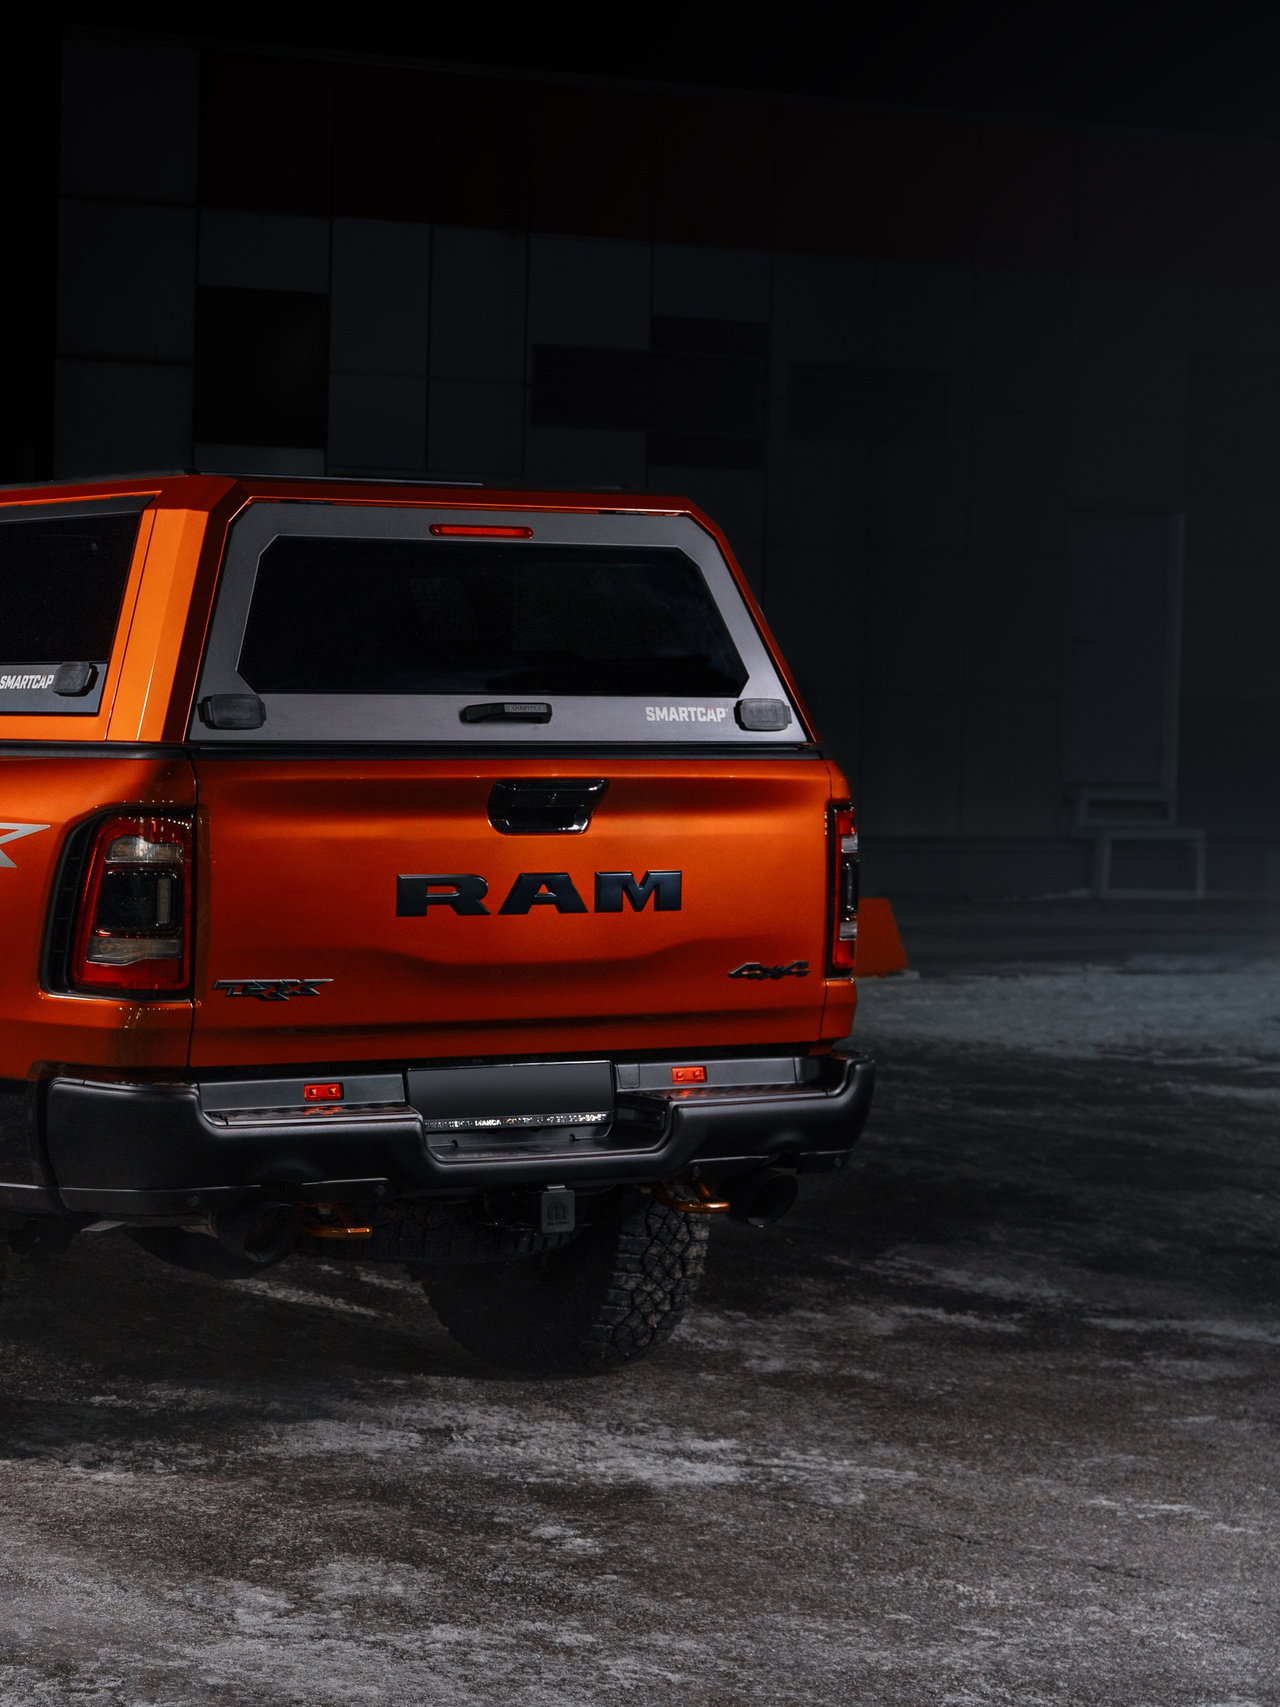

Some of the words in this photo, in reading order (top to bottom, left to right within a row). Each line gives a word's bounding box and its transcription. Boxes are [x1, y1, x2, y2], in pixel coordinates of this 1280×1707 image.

[645, 706, 728, 722] SMARTCAP
[396, 870, 683, 917] RAM
[212, 979, 334, 1001] TRX
